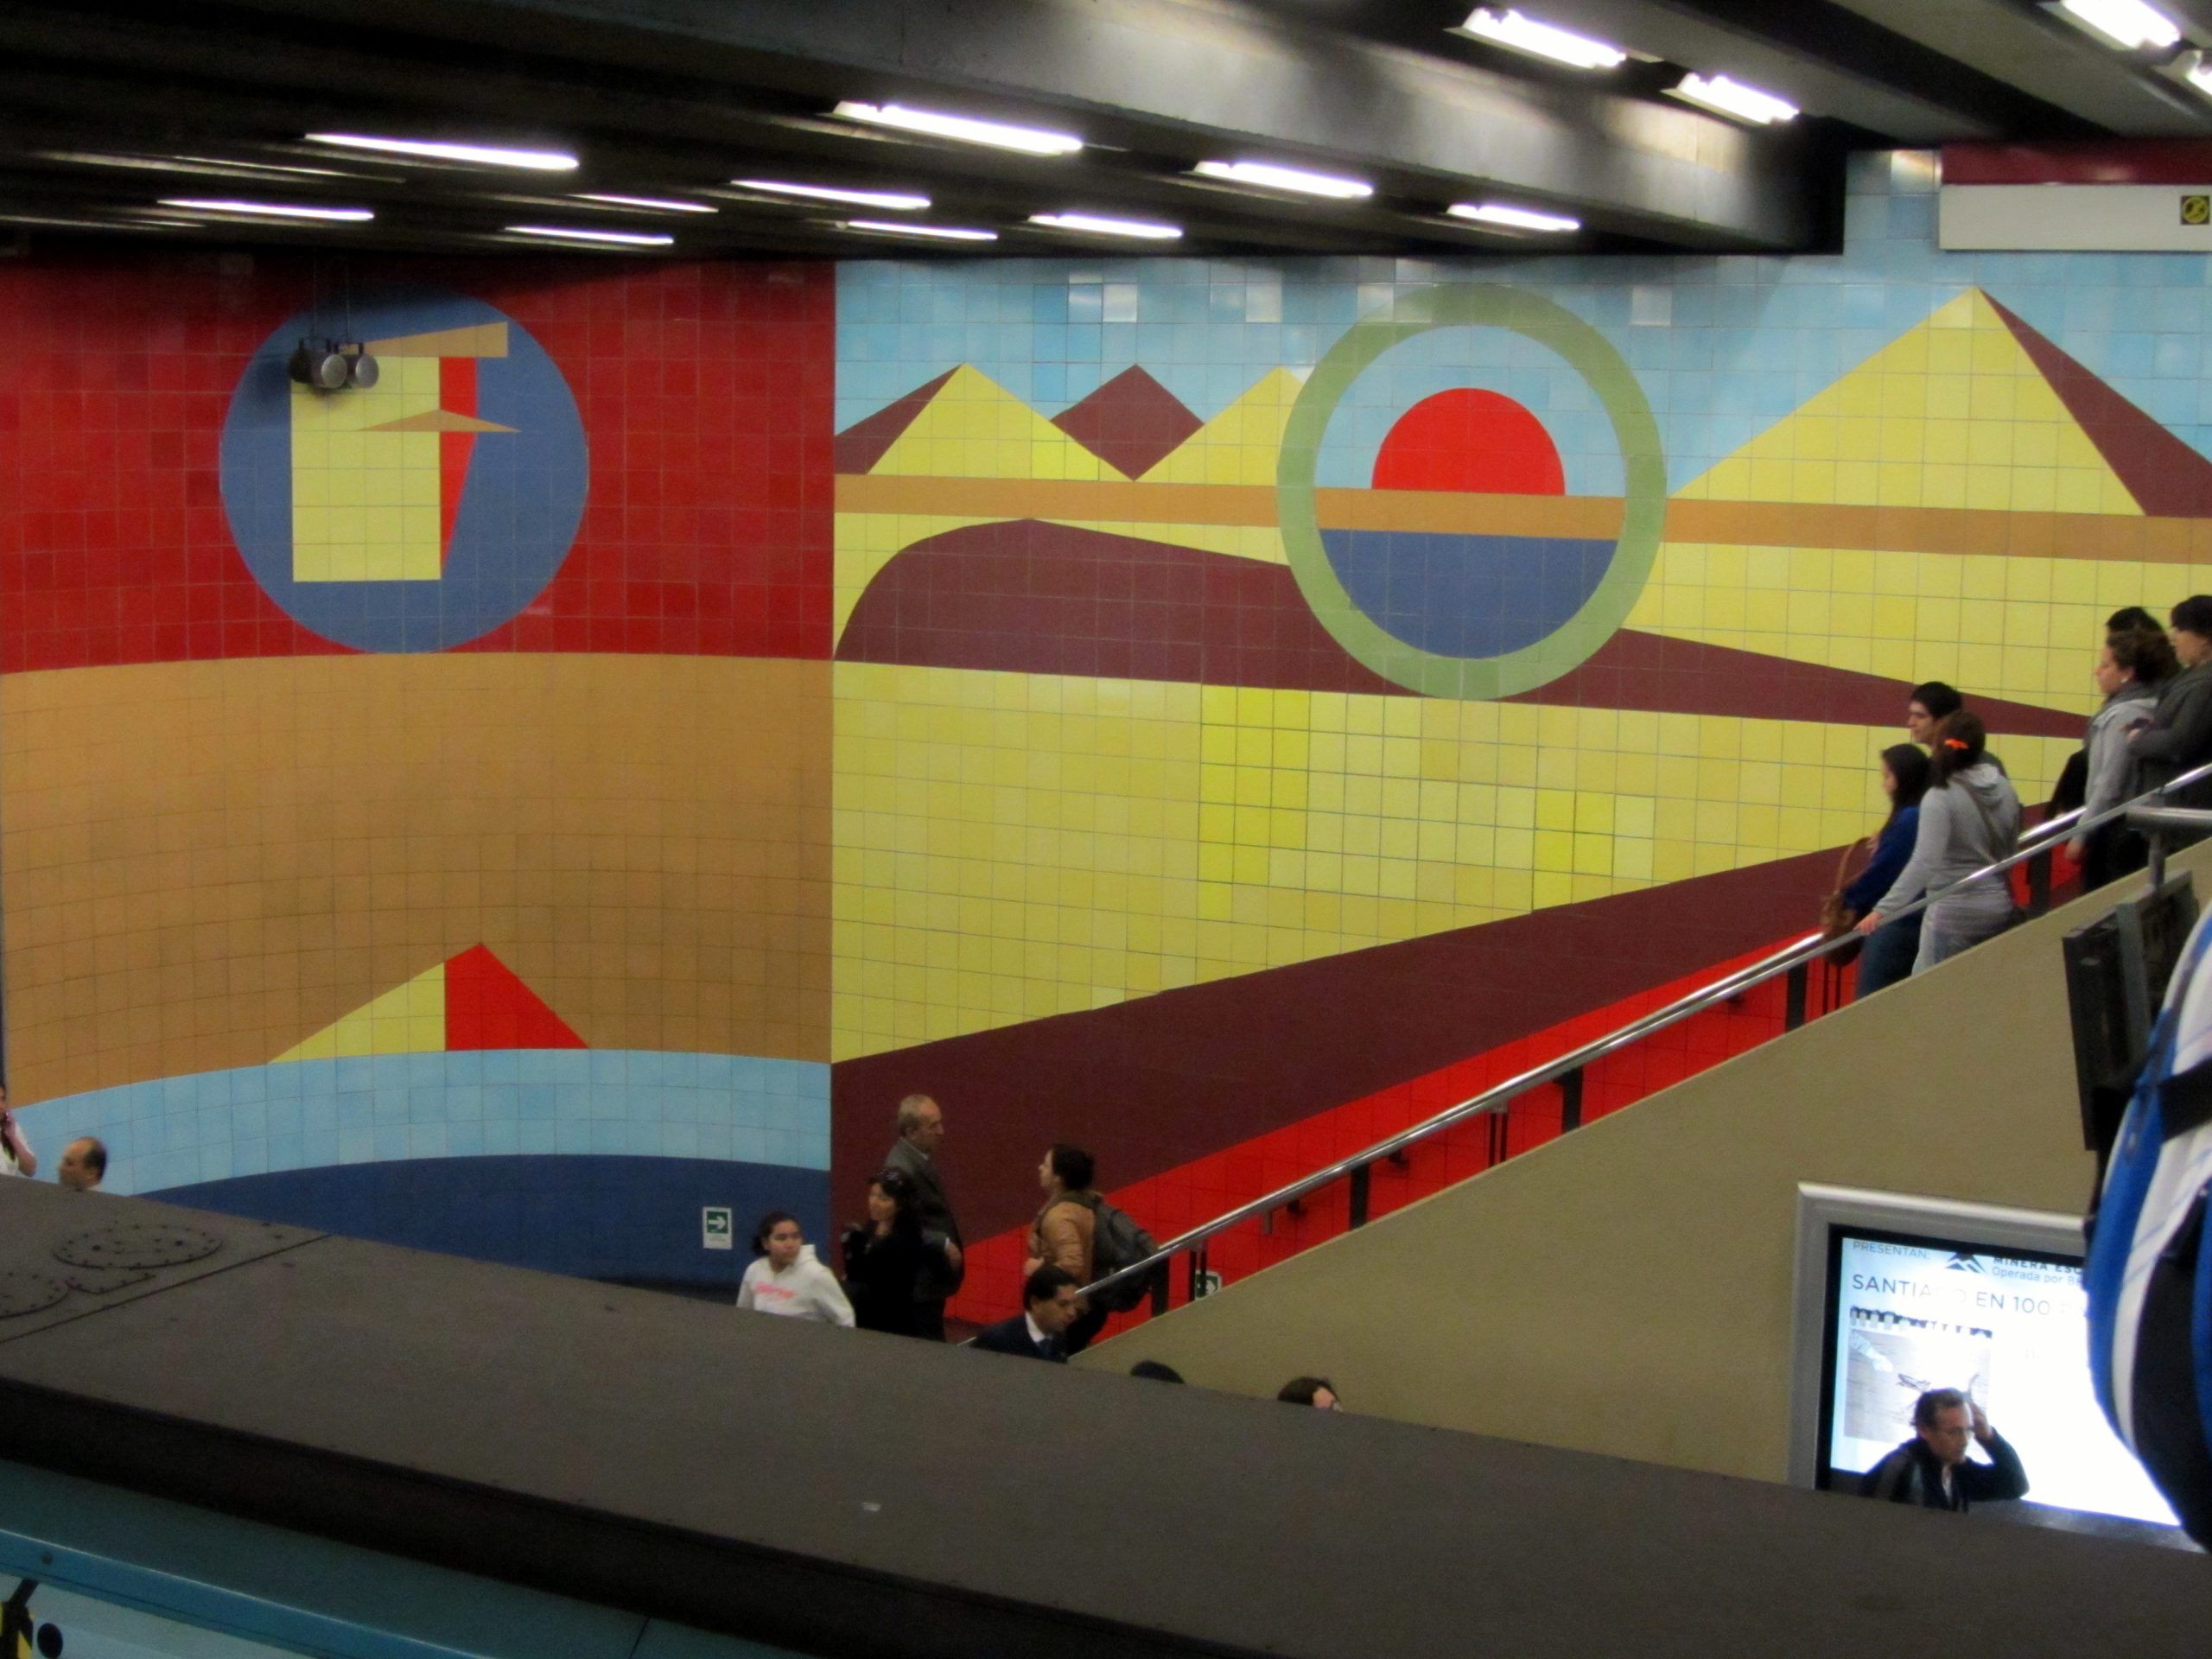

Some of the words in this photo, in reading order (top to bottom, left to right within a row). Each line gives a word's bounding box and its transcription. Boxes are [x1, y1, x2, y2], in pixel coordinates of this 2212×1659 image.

[1992, 1266, 2040, 1282] Operada
[2044, 1274, 2063, 1284] por
[1852, 1273, 1968, 1304] SANTIAO
[1976, 1291, 2005, 1310] EN
[2012, 1296, 2050, 1316] 100
